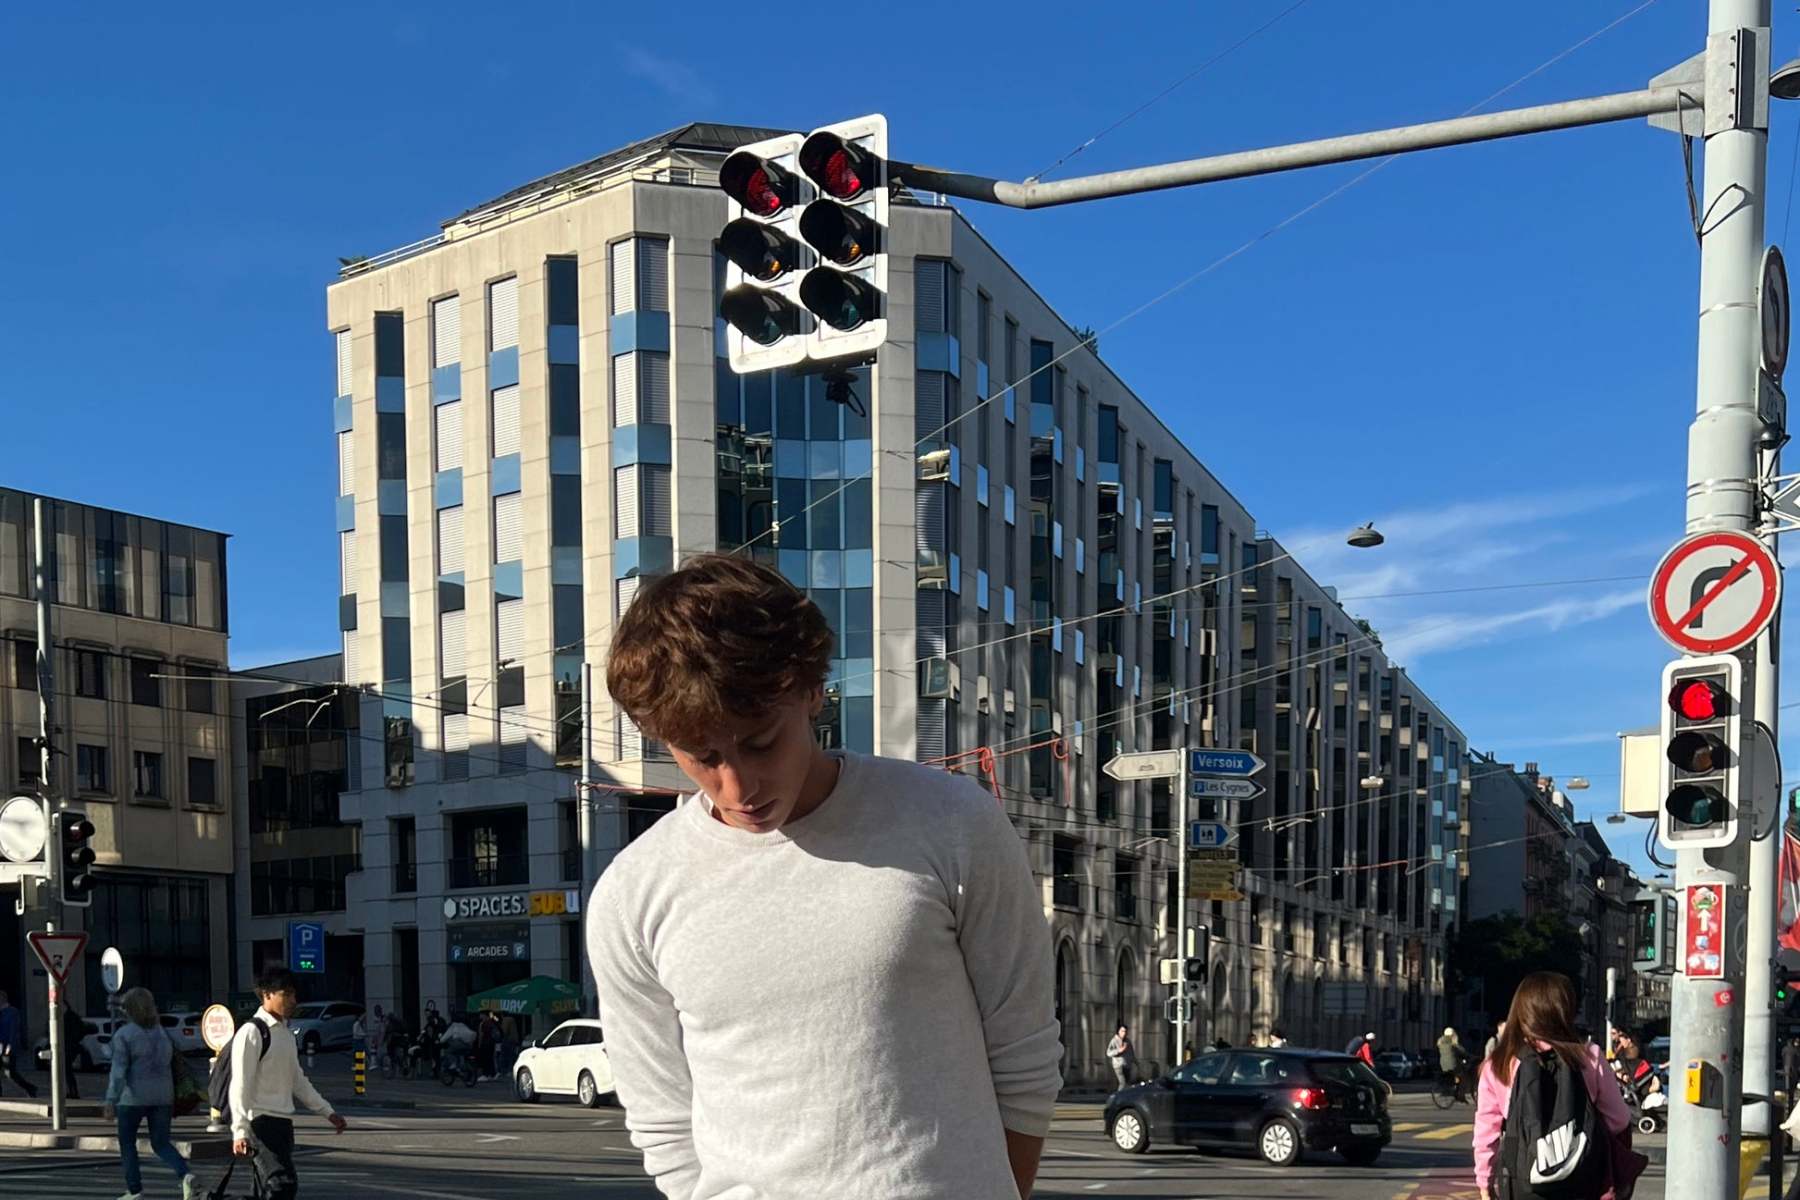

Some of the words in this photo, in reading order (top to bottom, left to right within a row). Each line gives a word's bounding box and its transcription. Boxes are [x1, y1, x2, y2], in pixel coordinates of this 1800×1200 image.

[1197, 754, 1244, 769] Versoix
[1206, 781, 1219, 791] Les
[1220, 781, 1249, 795] Cygnes
[459, 895, 526, 917] SPACES.
[467, 945, 509, 957] ARCADES
